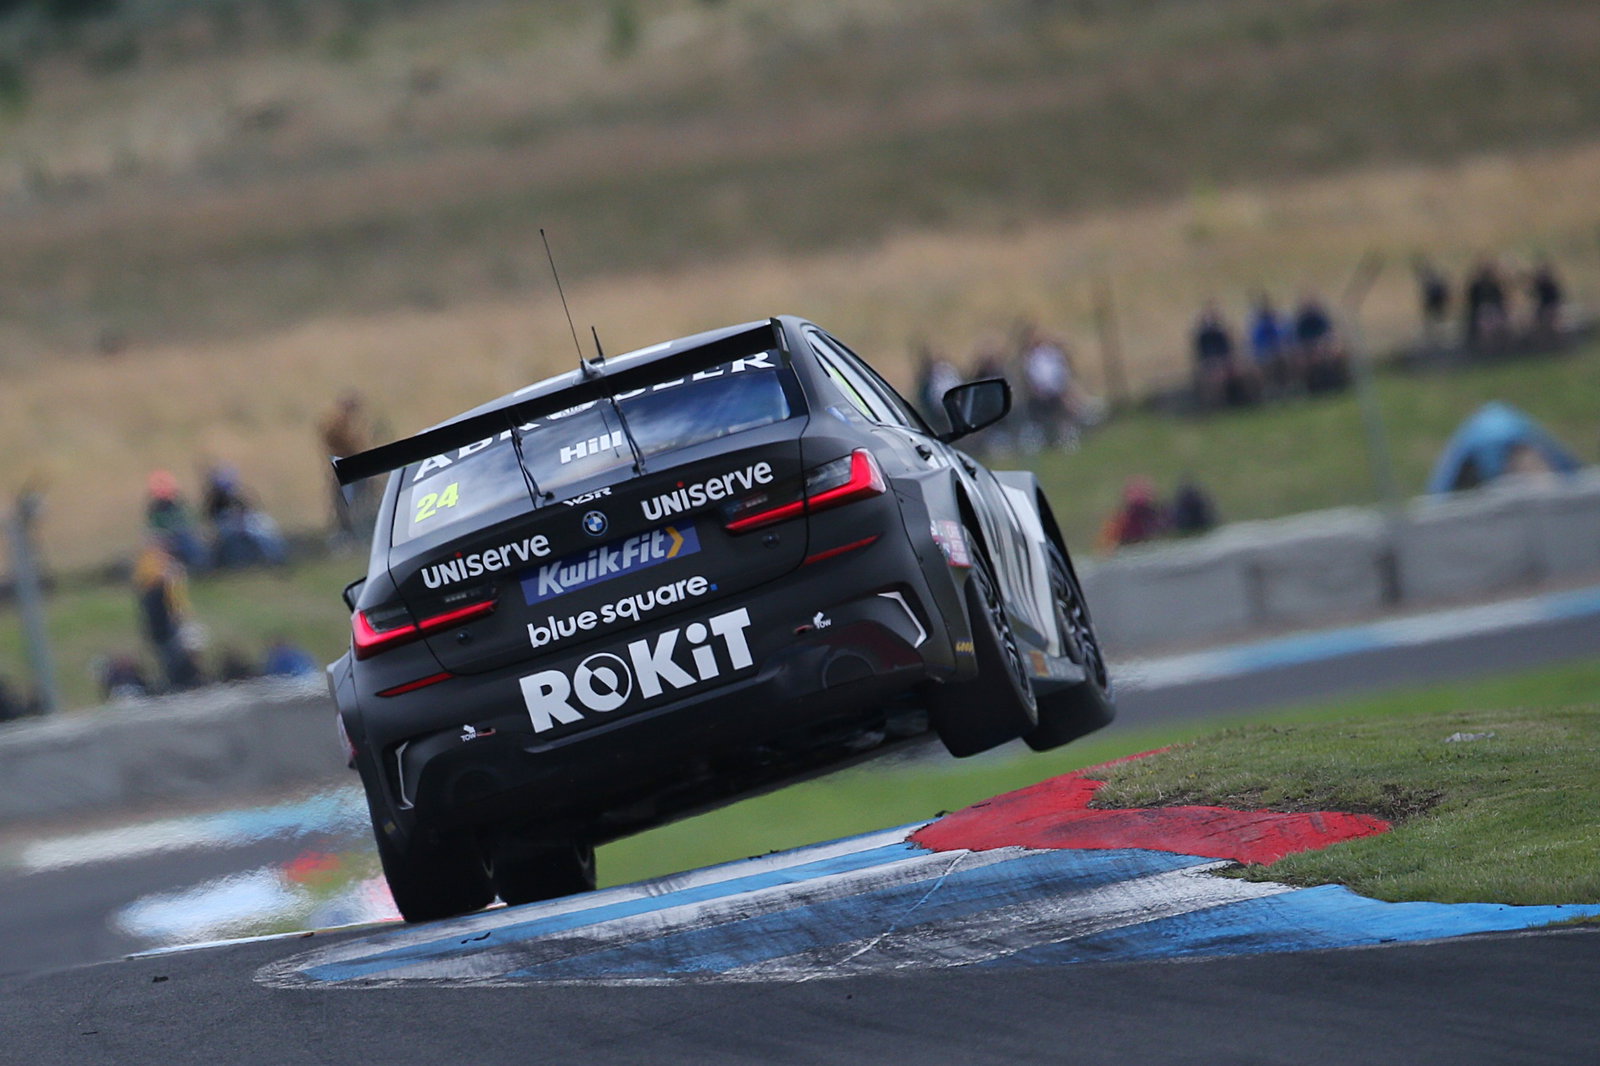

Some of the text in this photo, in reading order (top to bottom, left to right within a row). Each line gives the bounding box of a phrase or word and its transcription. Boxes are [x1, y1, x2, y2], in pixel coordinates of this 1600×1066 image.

[560, 431, 623, 464] Hill
[414, 482, 460, 523] 24
[562, 487, 612, 507] WSR
[527, 615, 598, 649] blue
[519, 607, 754, 735] ROKiT
[460, 731, 477, 743] TOW
